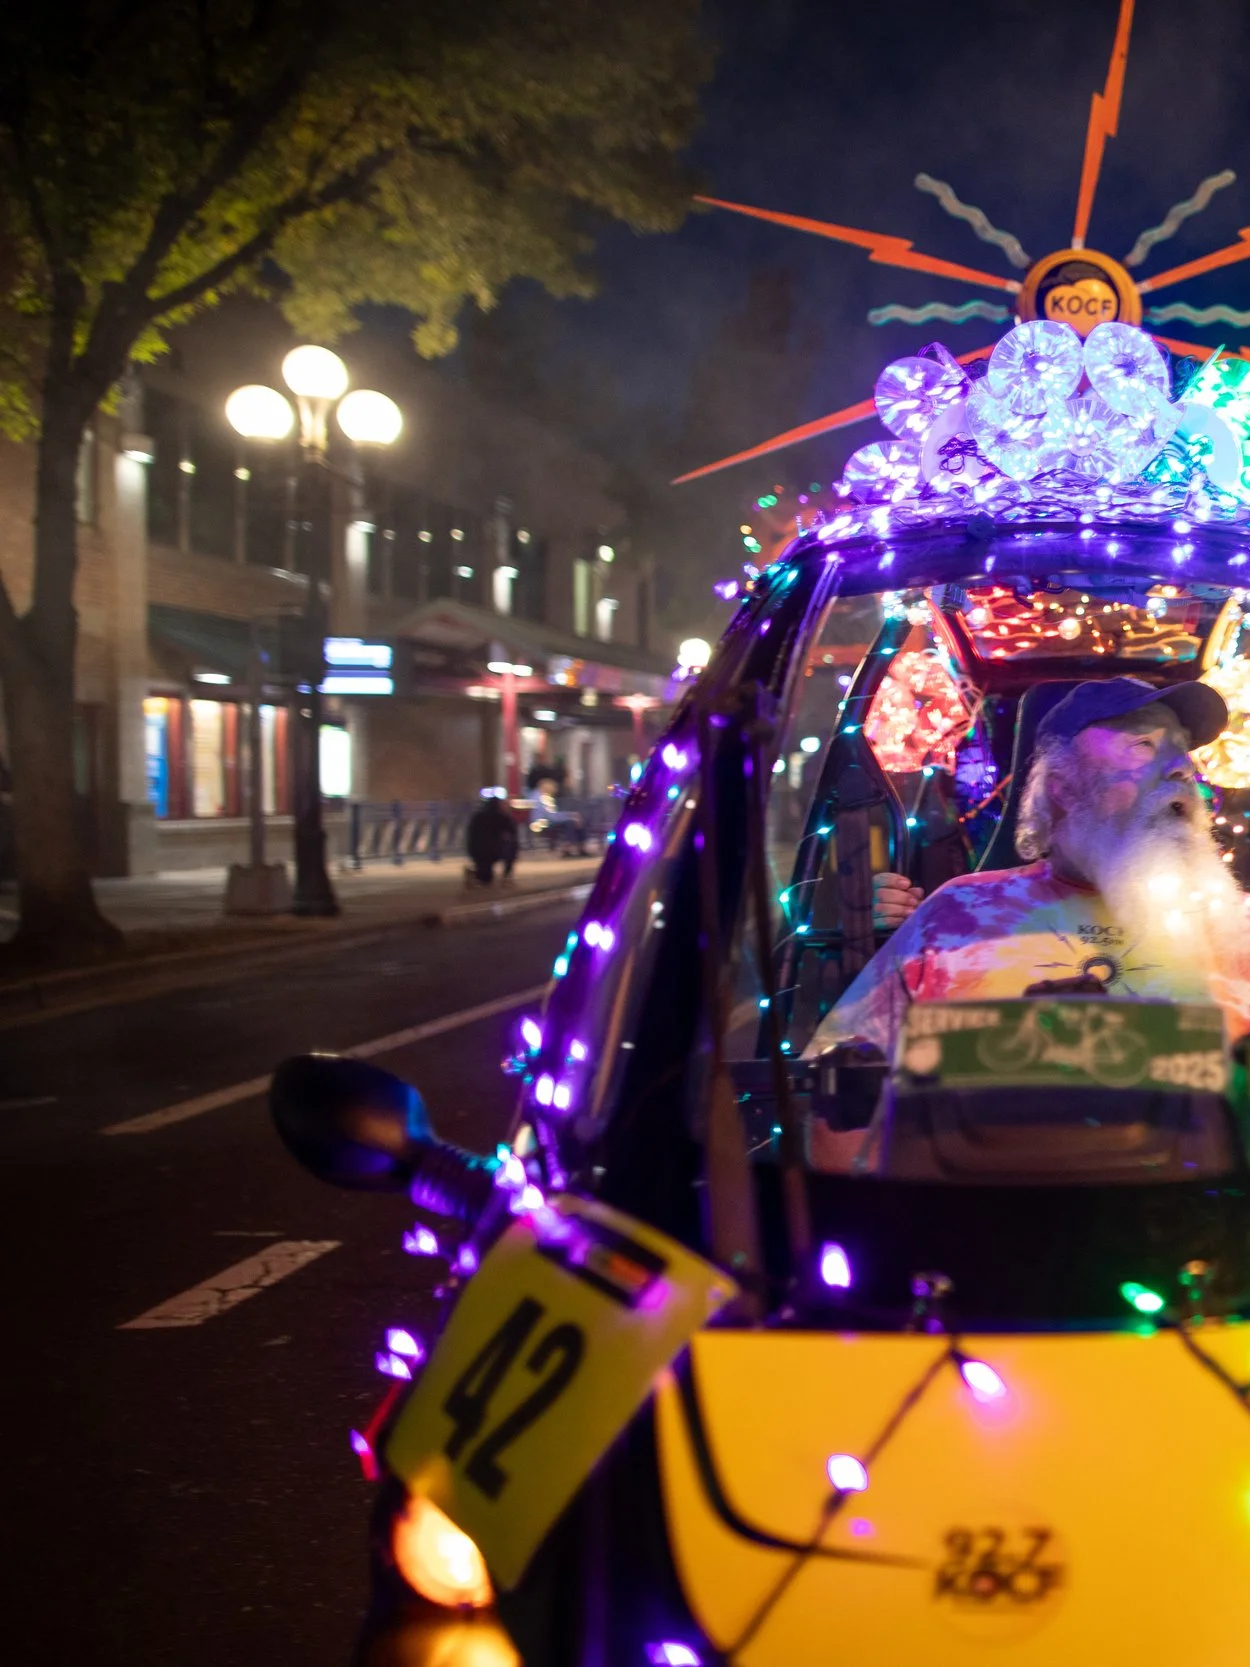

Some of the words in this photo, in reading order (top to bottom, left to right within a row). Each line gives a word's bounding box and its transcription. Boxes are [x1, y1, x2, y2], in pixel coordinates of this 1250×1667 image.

[1051, 295, 1112, 315] KOCF
[1150, 1050, 1225, 1092] 2025
[443, 1296, 586, 1502] 42
